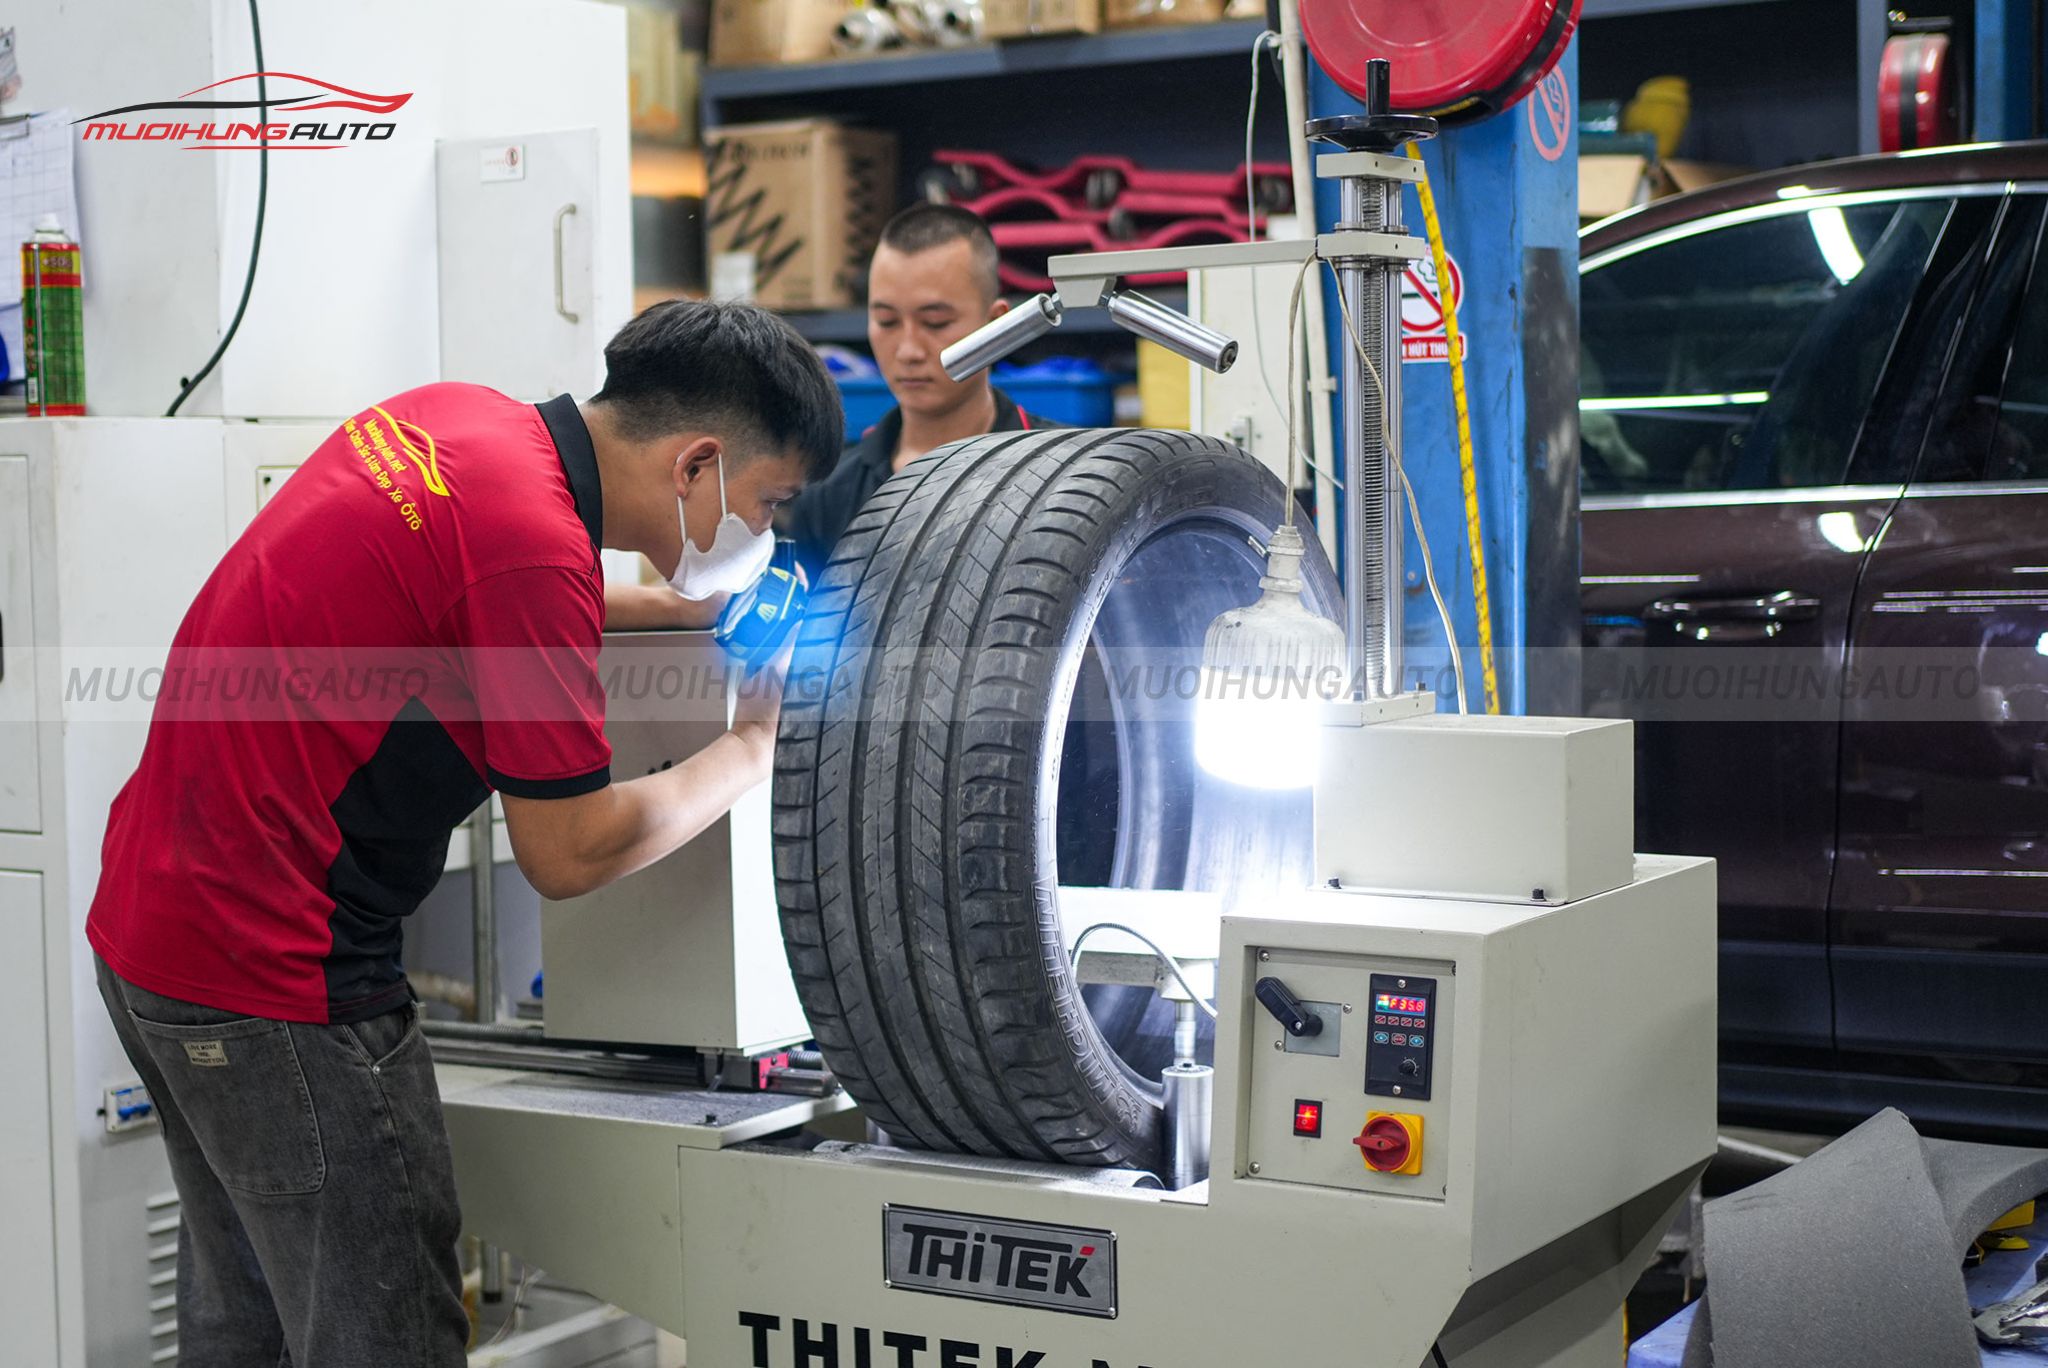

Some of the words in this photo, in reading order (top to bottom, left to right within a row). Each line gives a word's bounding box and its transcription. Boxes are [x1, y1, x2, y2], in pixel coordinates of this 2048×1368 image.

[387, 486, 403, 503] Xe
[400, 502, 423, 531] ÔTÔ
[1032, 874, 1118, 1104] MICHELIN
